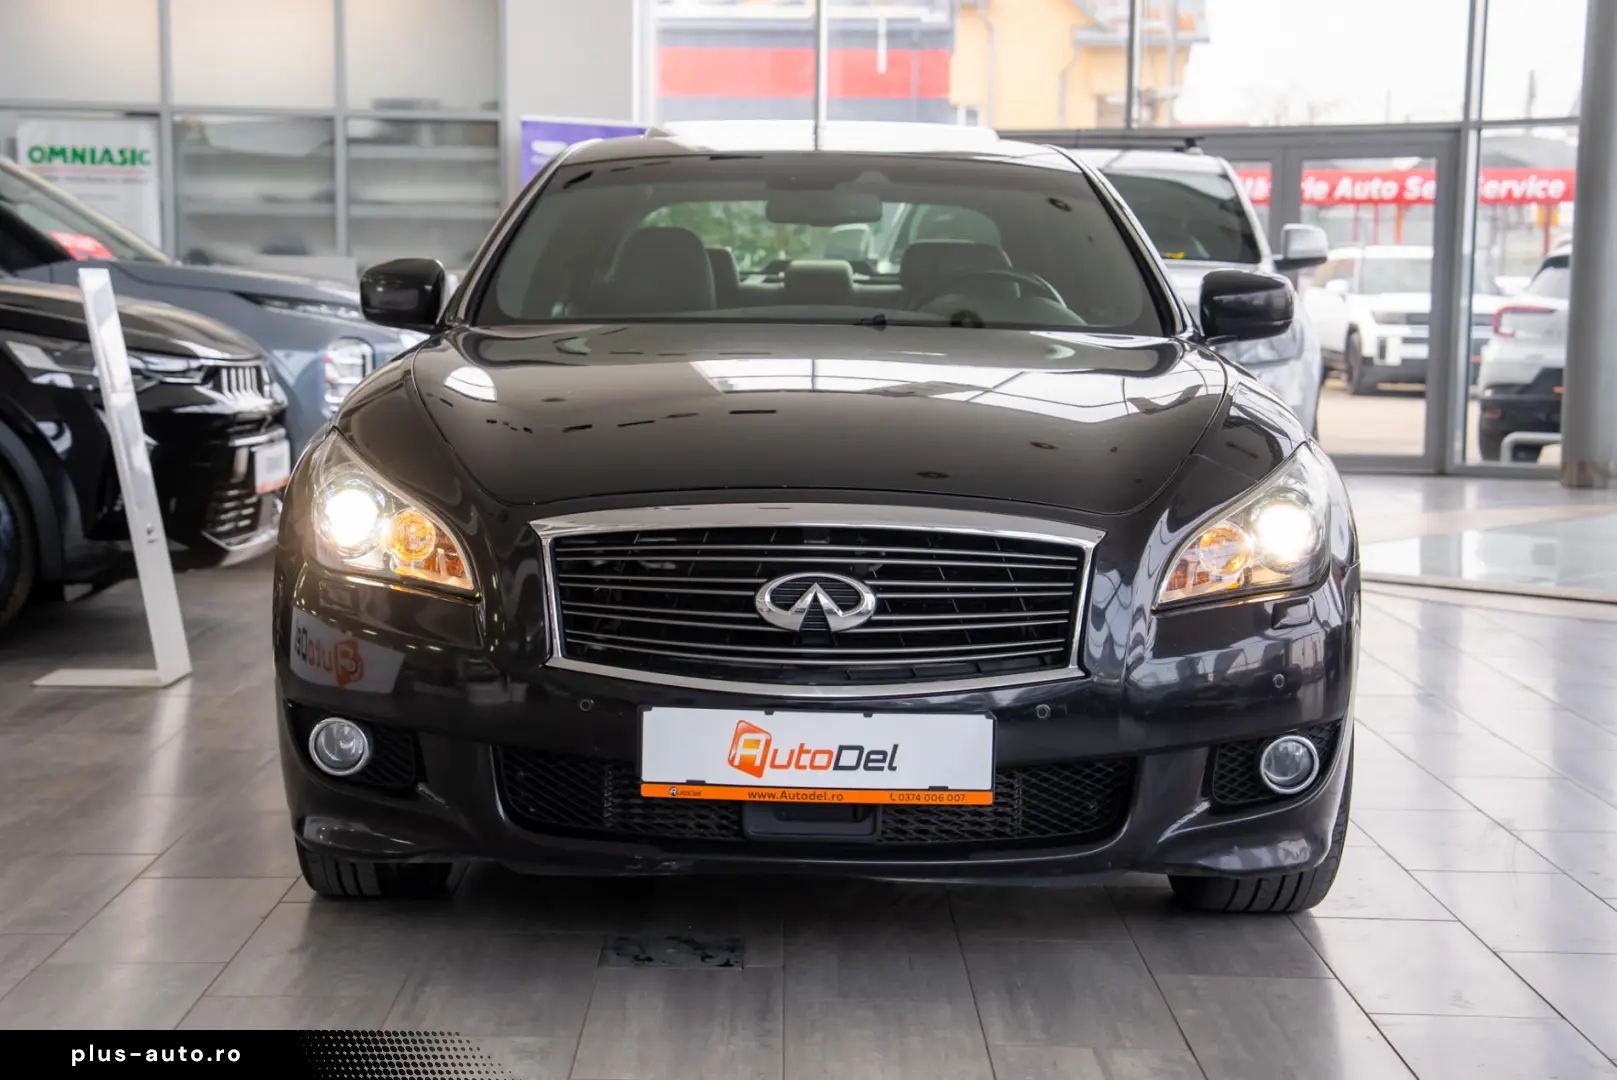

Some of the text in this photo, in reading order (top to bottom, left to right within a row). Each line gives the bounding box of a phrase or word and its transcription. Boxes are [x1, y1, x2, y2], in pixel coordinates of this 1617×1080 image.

[1334, 176, 1399, 201] Auto
[1478, 174, 1566, 200] ervice
[728, 720, 899, 778] AutoDel
[747, 789, 844, 801] www.Autodel.ro
[898, 793, 966, 803] 0374 006 007
